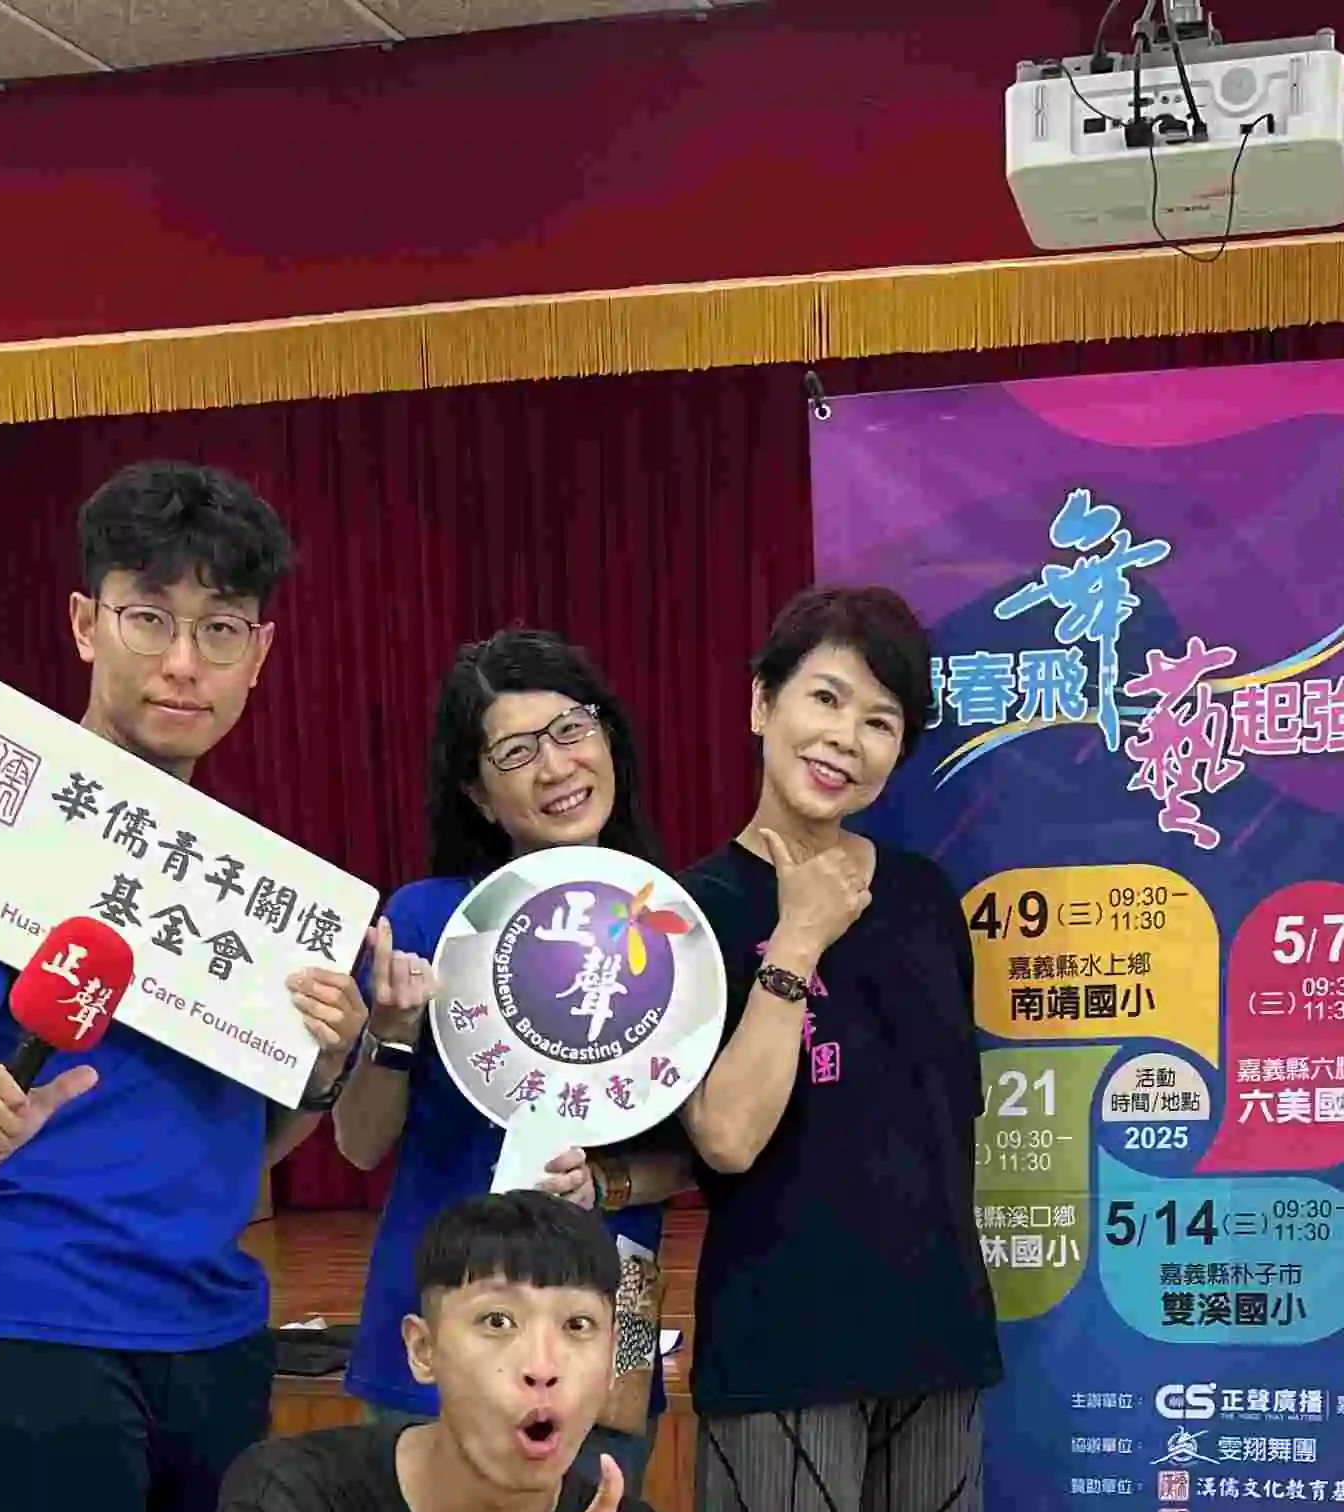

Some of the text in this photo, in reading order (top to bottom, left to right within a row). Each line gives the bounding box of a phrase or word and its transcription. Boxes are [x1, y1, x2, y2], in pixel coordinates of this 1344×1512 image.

[52, 771, 343, 963] 華儒青年關懷
[89, 873, 254, 981] 基金會
[970, 890, 1049, 940] 4/9
[1111, 910, 1166, 931] 11:30
[534, 890, 629, 1042] 正聲
[1008, 952, 1152, 981] 嘉義縣水上鄉
[1010, 983, 1156, 1022] 南靖國小
[141, 976, 187, 1010] Care
[190, 1002, 299, 1069] Foundation
[514, 1015, 623, 1062] Broadcasting
[983, 1068, 1057, 1118] /21
[1135, 1067, 1176, 1089] 活動
[1111, 1091, 1201, 1112] 時間/地點
[1124, 1126, 1189, 1150] 2025
[999, 1153, 1051, 1171] 11:30
[1106, 1200, 1219, 1247] 5/14
[1274, 1222, 1330, 1242] 11:30
[980, 1234, 1080, 1268] 林國小
[1160, 1263, 1302, 1286] 嘉義縣朴子市
[1161, 1291, 1306, 1326] 雙溪國小
[1221, 1388, 1323, 1413] 正聲廣播
[1218, 1435, 1317, 1463] 雯翔舞團
